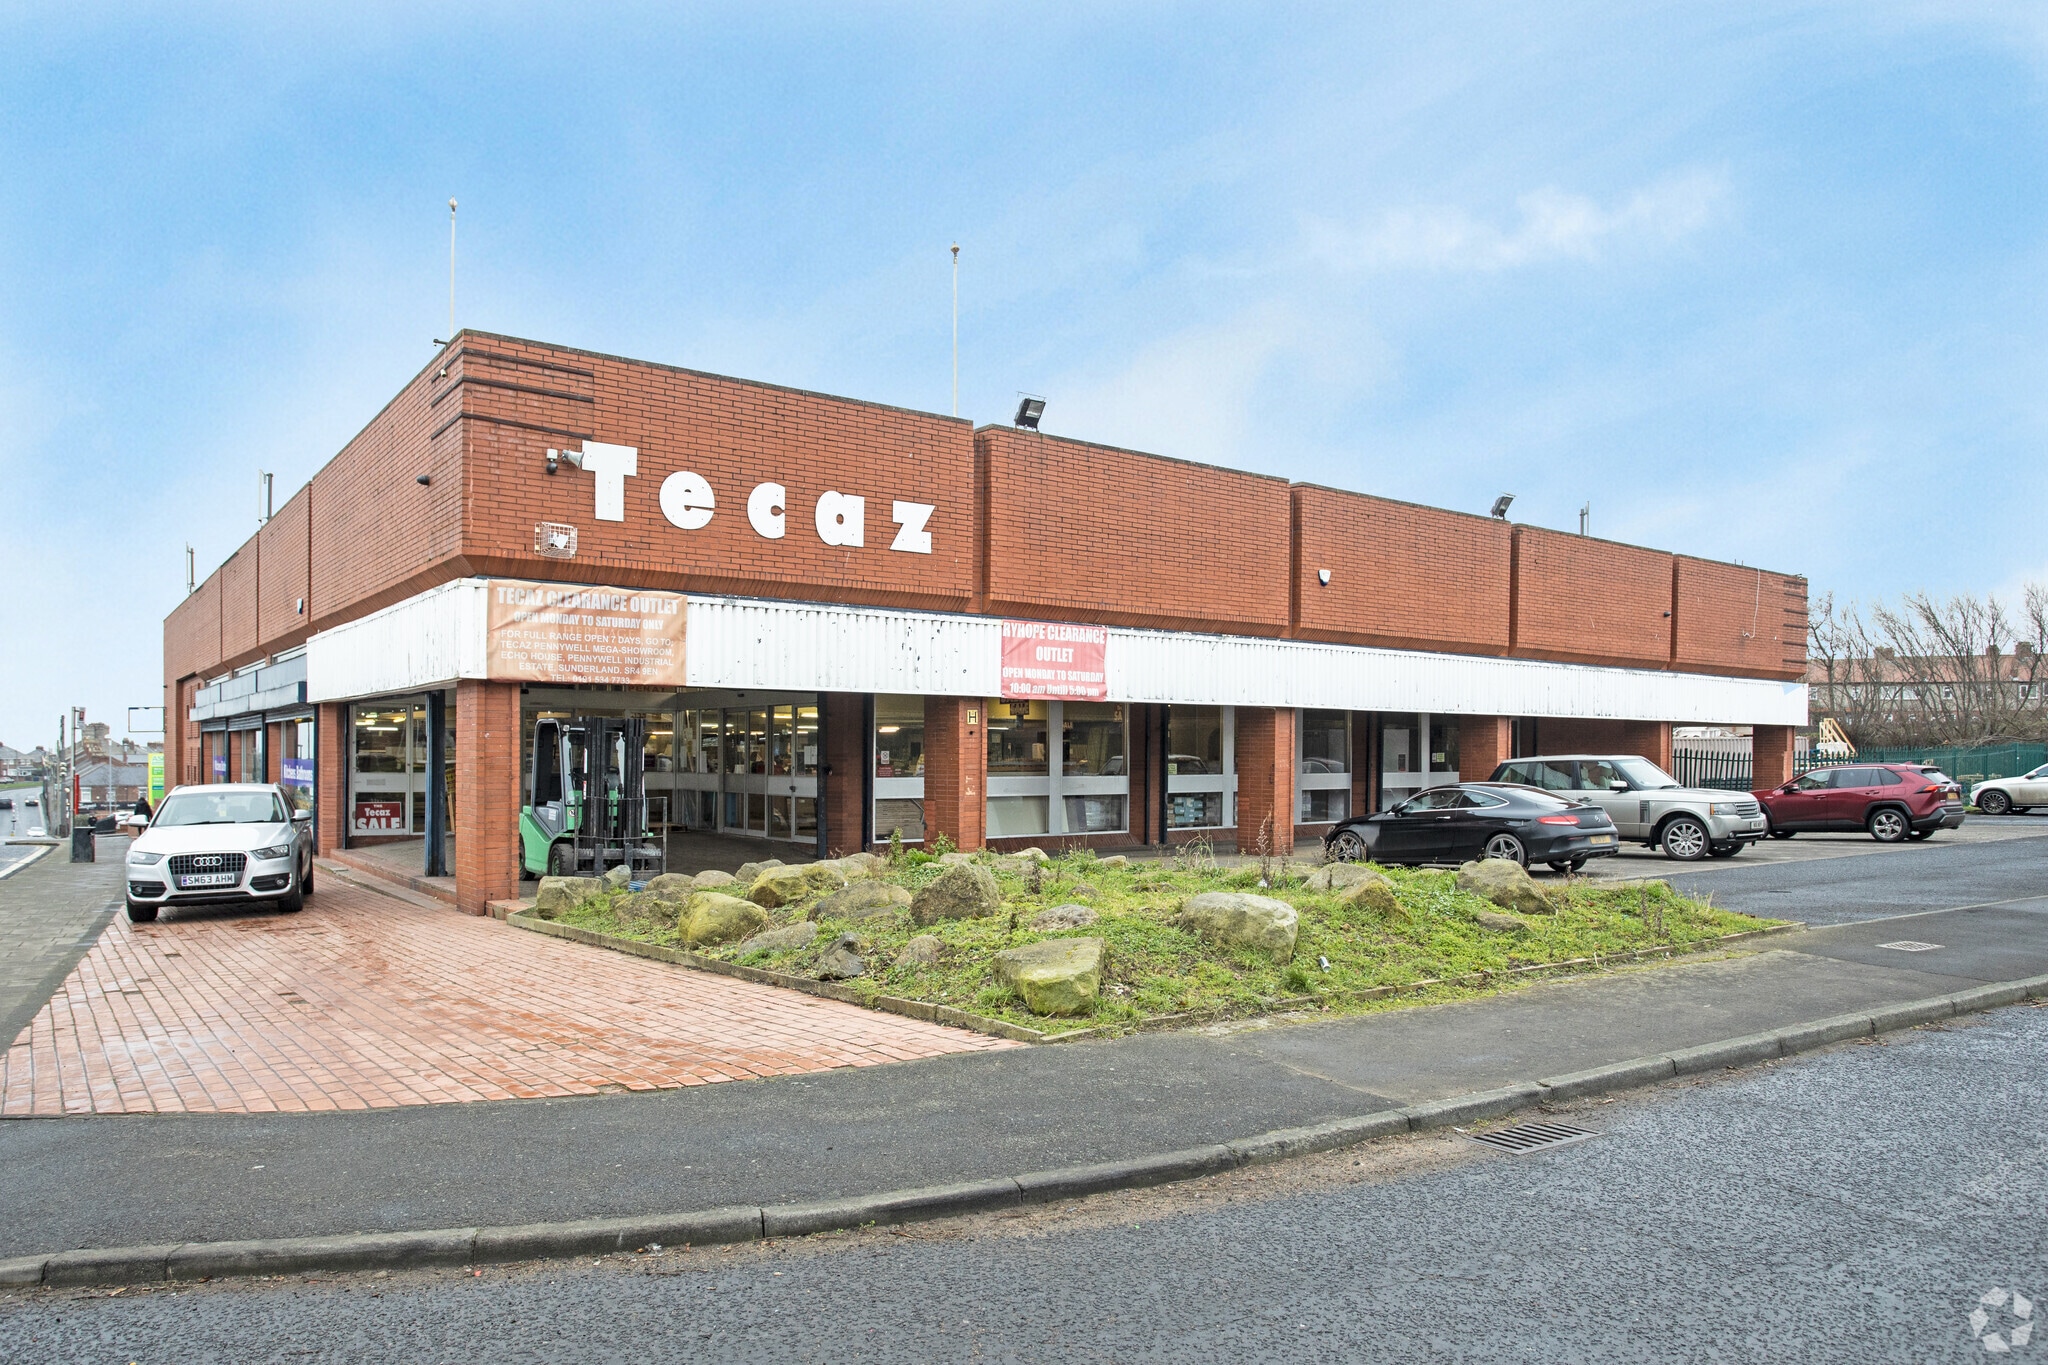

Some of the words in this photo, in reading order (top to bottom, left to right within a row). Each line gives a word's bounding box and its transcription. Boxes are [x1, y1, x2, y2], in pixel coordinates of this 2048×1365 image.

[582, 440, 936, 554] Tecaz
[497, 587, 544, 606] TECAZ
[547, 590, 627, 612] CLEARANCE
[630, 596, 679, 615] OUTLET
[514, 611, 539, 623] OPEN
[540, 612, 580, 625] MONDAY
[582, 615, 594, 626] TO
[596, 616, 640, 629] SATURDAY
[642, 619, 664, 630] ONLY
[501, 630, 520, 638] FOR
[523, 630, 547, 640] FULL
[549, 632, 582, 642] RANGE
[584, 634, 608, 643] OPEN
[611, 635, 616, 643] 7
[646, 637, 658, 645] GO
[1003, 622, 1045, 640] RYHOPE
[1047, 625, 1105, 645] CLEARANCE
[501, 641, 531, 649] TECAZ
[534, 642, 590, 652] PENNYWELL
[592, 645, 674, 657] MEGA-SHOWROOM,
[1036, 646, 1074, 663] OUTLET
[501, 651, 528, 660] ECHO
[530, 652, 565, 662] HOUSE,
[567, 654, 622, 664] PENNYWELL
[624, 657, 673, 666] INDUSTRIAL
[550, 674, 570, 682] TEL:
[572, 675, 592, 683] 0191
[624, 667, 640, 675] SR4
[642, 667, 658, 675] 9EN
[1003, 667, 1023, 678] OPEN
[1024, 668, 1055, 680] MONDAY
[1057, 670, 1066, 681] TO
[1068, 671, 1104, 683] SATURDAY
[1010, 682, 1031, 693] 10:00
[1032, 684, 1045, 694] am
[1069, 685, 1086, 696] 5:00
[1087, 687, 1099, 697] pm
[968, 711, 977, 723] H
[364, 807, 391, 816] Tecaz
